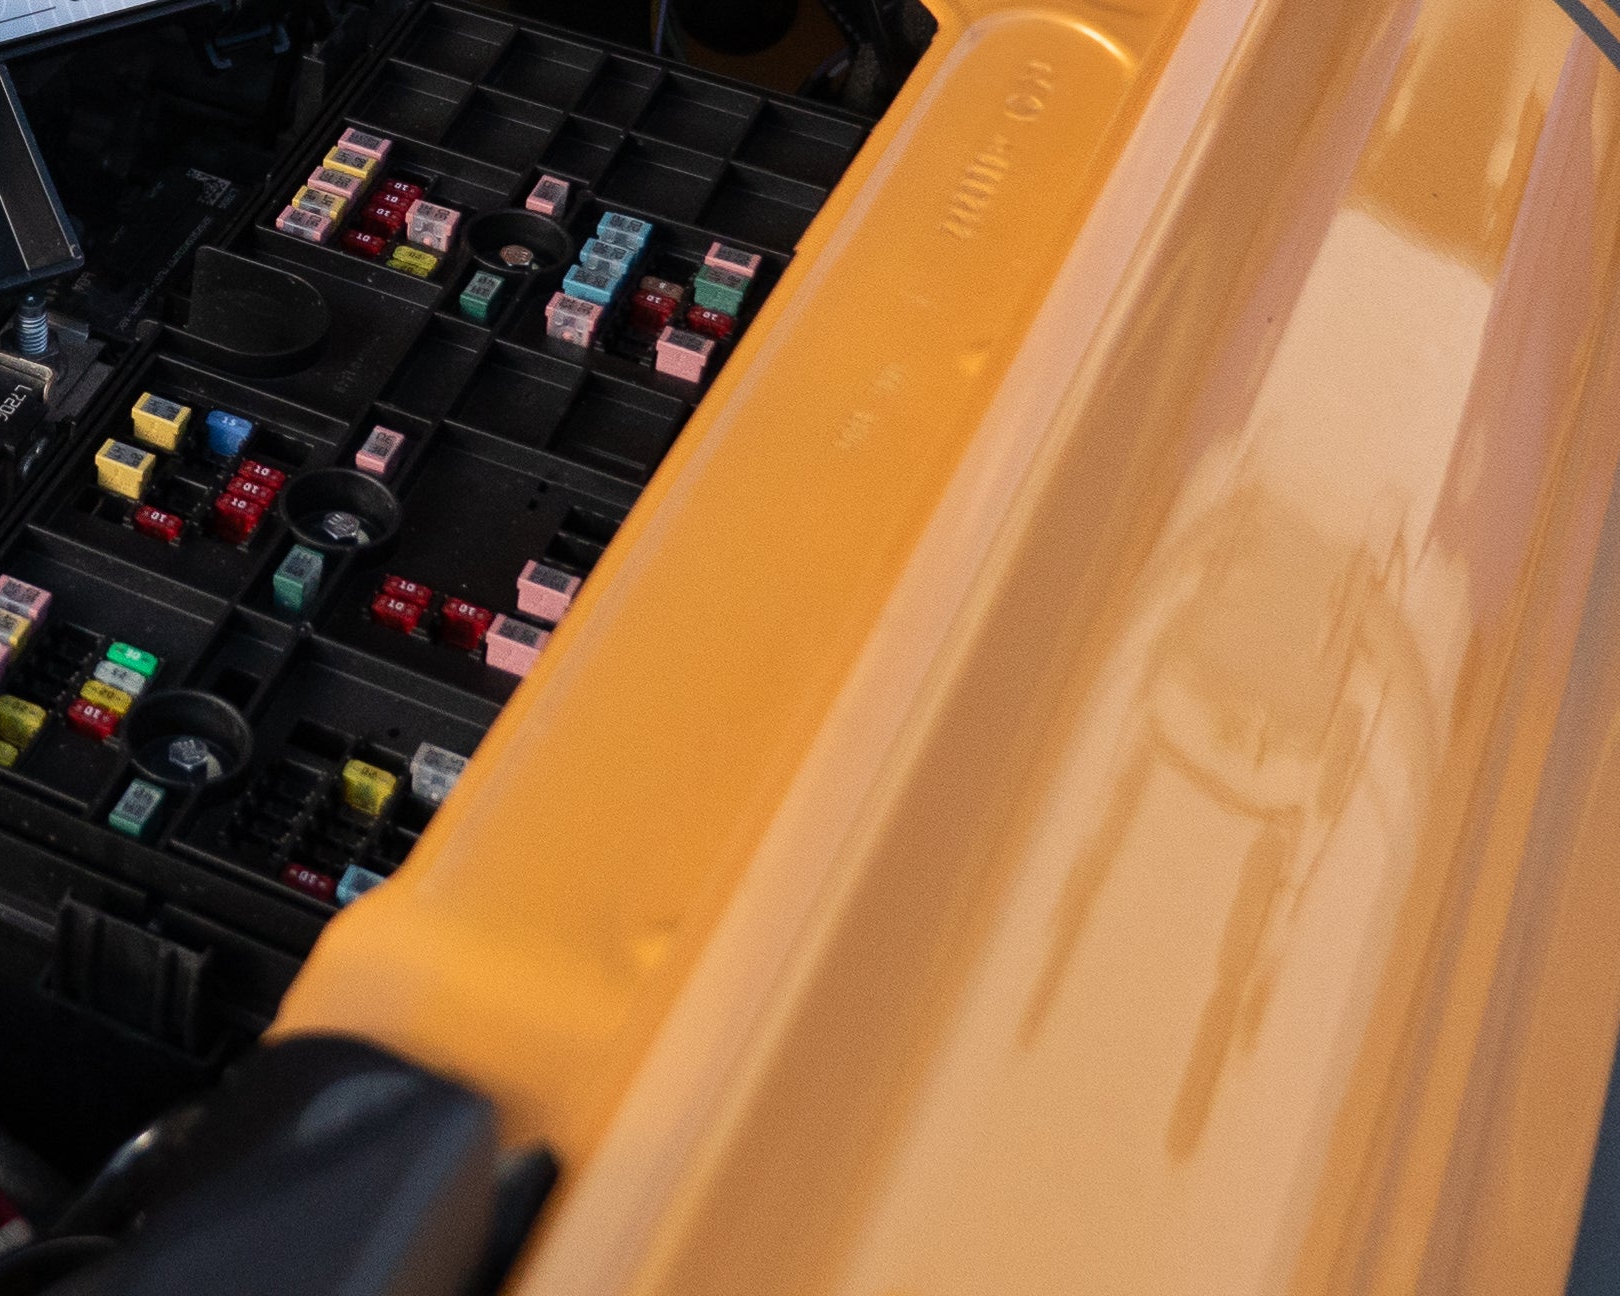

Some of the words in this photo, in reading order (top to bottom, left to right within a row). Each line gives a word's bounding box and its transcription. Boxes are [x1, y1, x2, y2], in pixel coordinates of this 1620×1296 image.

[395, 182, 409, 191] 10
[385, 195, 398, 203] 10
[376, 208, 390, 216] 10
[356, 233, 369, 242] 10
[221, 416, 236, 426] 15
[254, 466, 269, 476] 10
[243, 483, 259, 494] 10
[231, 498, 246, 508] 10
[150, 511, 166, 522] 10
[401, 581, 415, 592] 10
[387, 600, 403, 610] 10
[459, 604, 476, 616] 10
[84, 706, 100, 718] 10
